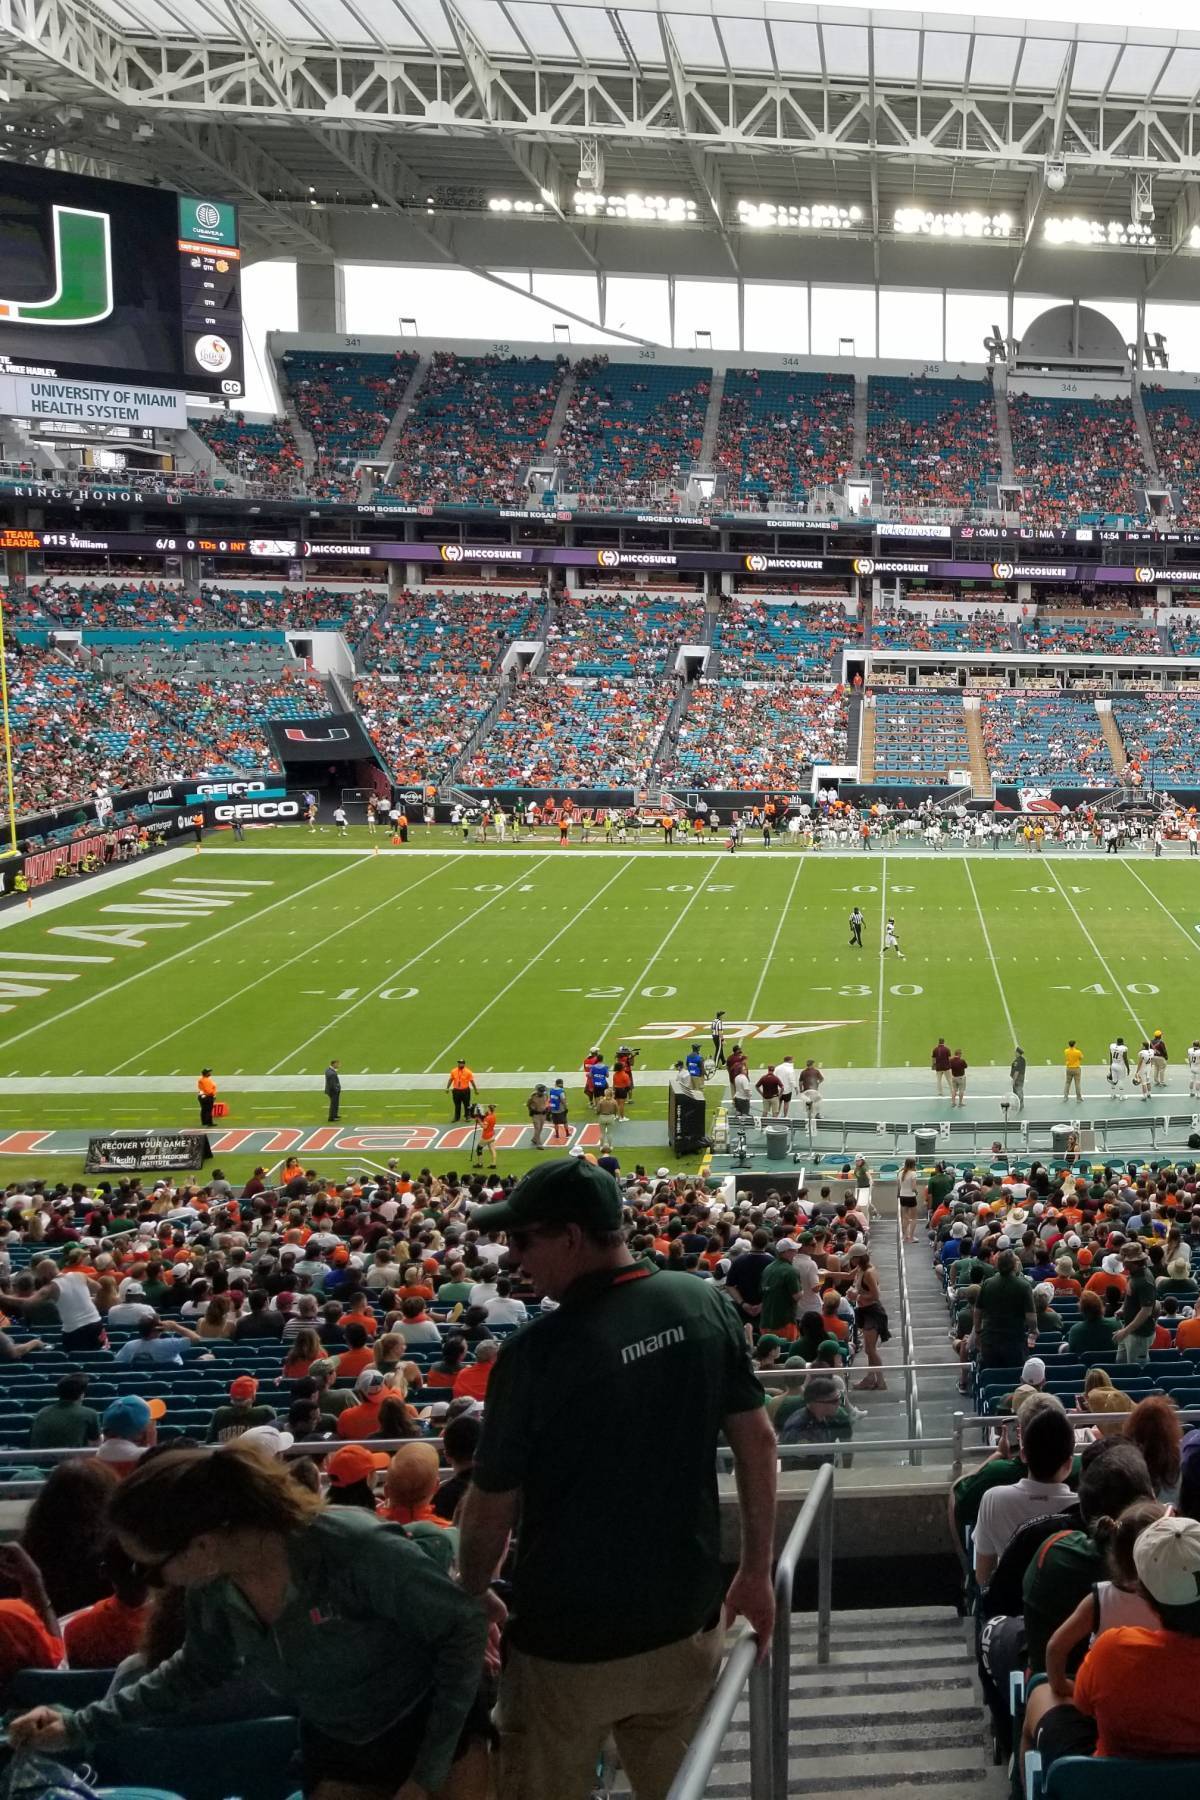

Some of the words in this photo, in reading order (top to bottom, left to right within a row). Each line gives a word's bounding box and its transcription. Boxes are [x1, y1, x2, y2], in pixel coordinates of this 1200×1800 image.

[345, 338, 361, 347] 341
[493, 344, 510, 353] 342
[639, 350, 655, 359] 343
[782, 357, 799, 366] 344
[923, 364, 940, 373] 345
[223, 382, 239, 393] CC
[1061, 383, 1077, 393] 346
[31, 383, 110, 401] UNIVERSITY
[113, 391, 130, 403] OF
[134, 392, 177, 408] MIAMI
[31, 400, 83, 416] HEALTH
[87, 404, 139, 420] SYSTEM
[15, 487, 62, 498] RING
[79, 490, 144, 502] HONOR
[357, 505, 375, 513] DON
[376, 506, 417, 514] BOSSELER
[499, 510, 528, 518] BERNIE
[637, 515, 673, 524] BURGESS
[674, 517, 703, 525] OWENS
[767, 520, 804, 528] EDGERRIN
[806, 521, 831, 529] JAMES
[4, 530, 34, 540] TEAM
[43, 534, 67, 546] #15
[979, 527, 999, 537] CMU
[1001, 528, 1007, 537] 0
[1039, 531, 1055, 540] MIA
[1099, 531, 1120, 541] 14:54
[1183, 534, 1192, 543] 11
[1, 538, 40, 549] LEADER
[70, 538, 108, 549] Williams
[156, 539, 176, 550] 6/8
[187, 540, 195, 550] 0
[199, 540, 216, 550] TDs
[219, 541, 226, 551] 0
[230, 542, 246, 551] INT
[312, 545, 370, 555] MICCOSUKEE
[464, 548, 521, 559] MICCOSUKEE
[620, 554, 677, 564] MICCOSUKEE
[768, 559, 823, 569] MICCOSUKEE
[874, 562, 929, 573] MICCOSUKEE
[1014, 566, 1067, 576] MICCOSUKEE
[285, 727, 350, 742] U
[196, 781, 265, 795] GEICO
[214, 801, 299, 821] GEICO
[327, 986, 420, 1001] 10
[582, 985, 678, 999] 20
[837, 983, 924, 997] 30
[1079, 983, 1161, 995] 40
[101, 1142, 138, 1150] RECOVER
[140, 1141, 162, 1149] YOUR
[620, 1325, 685, 1365] miami
